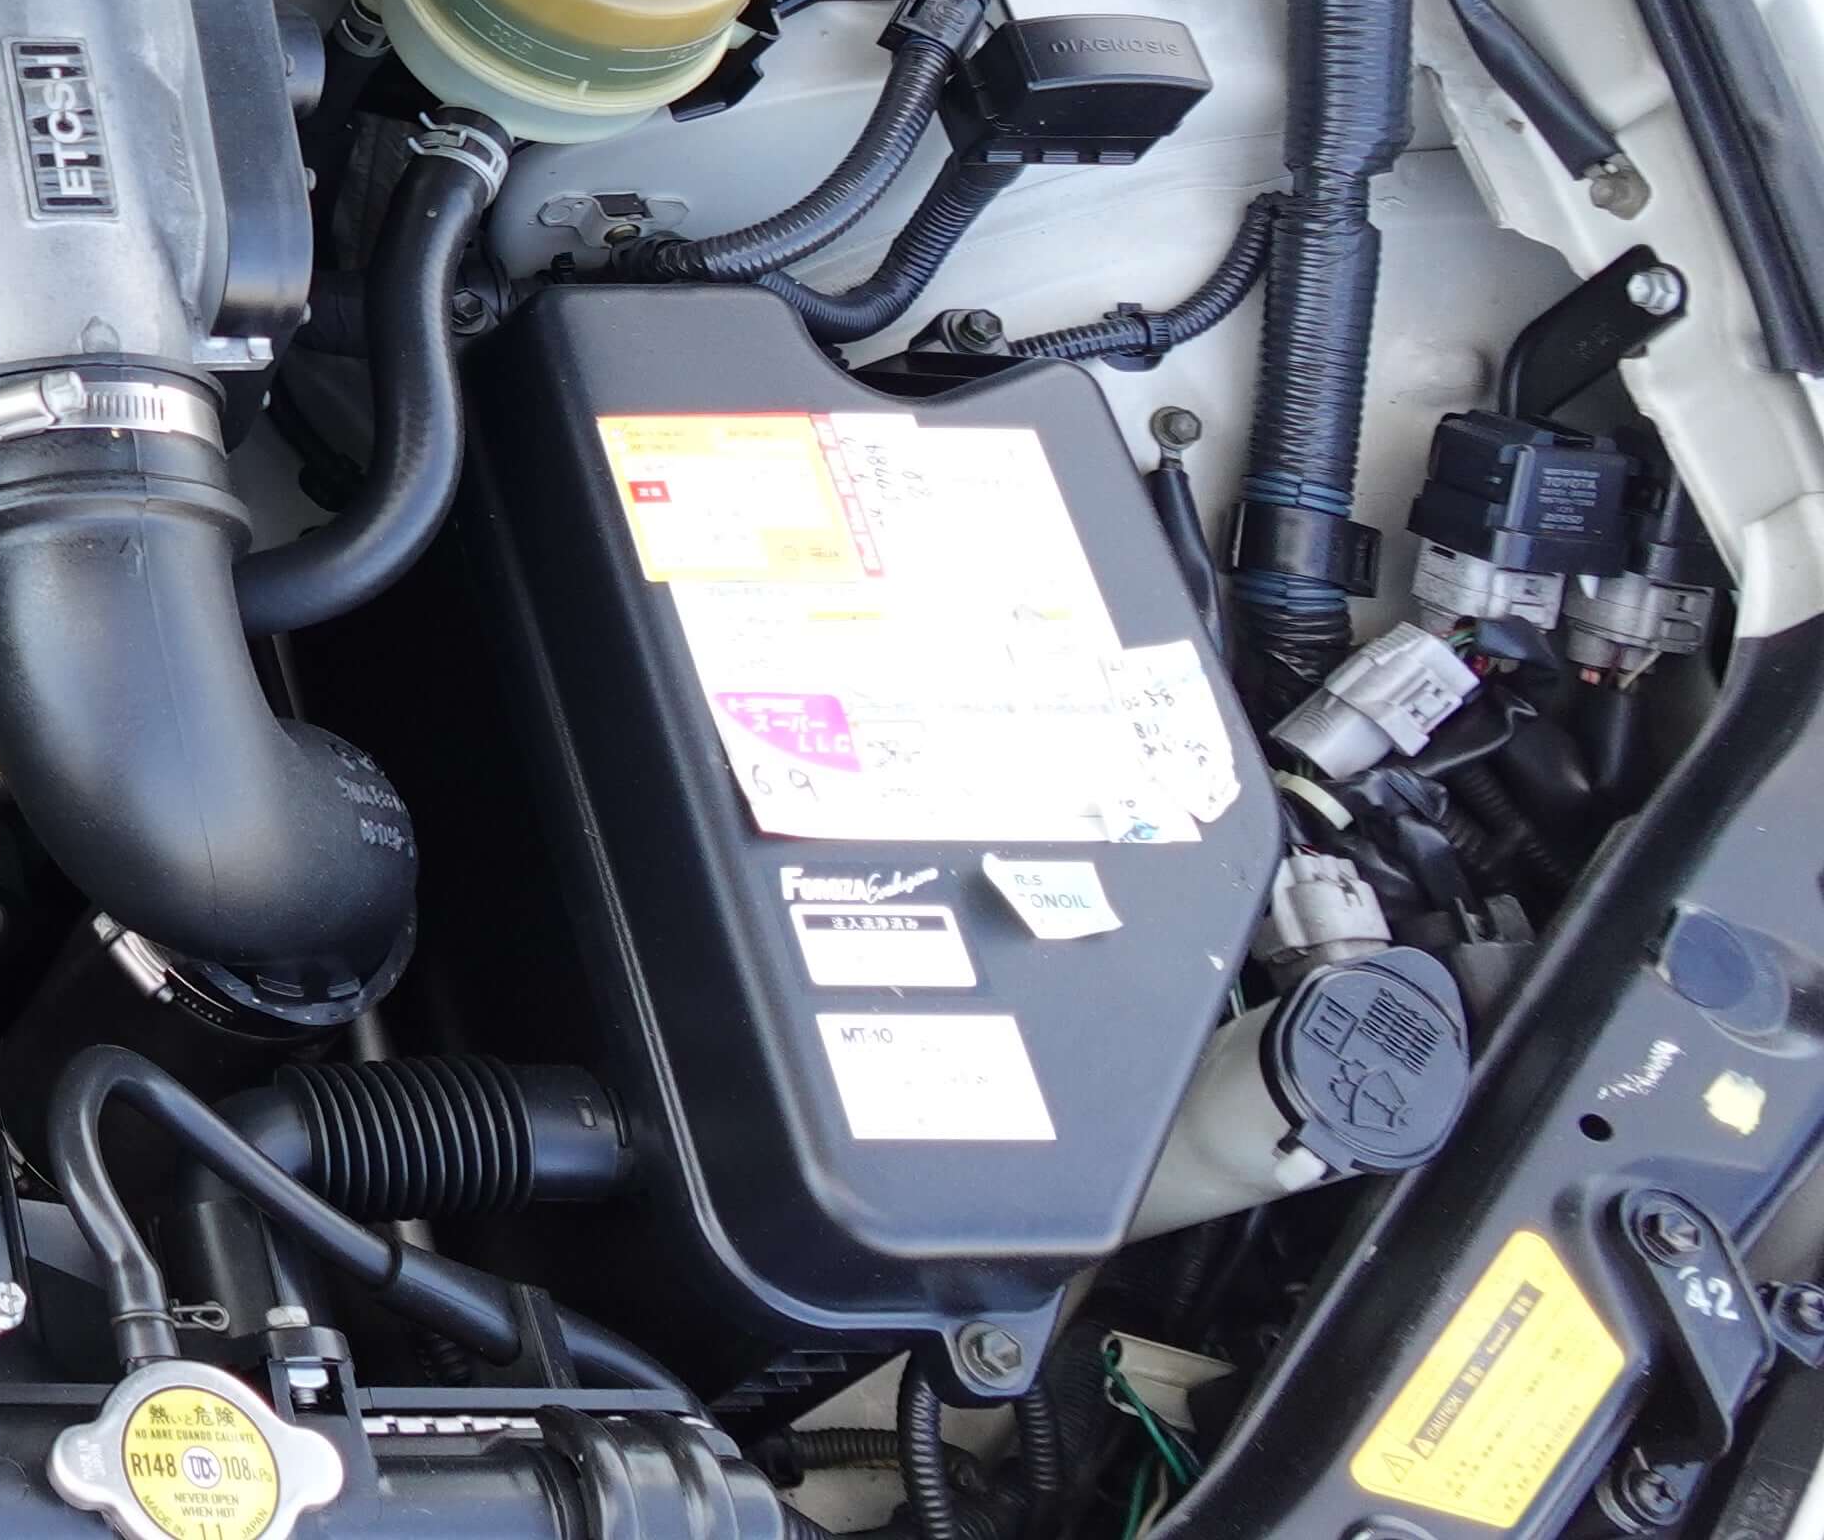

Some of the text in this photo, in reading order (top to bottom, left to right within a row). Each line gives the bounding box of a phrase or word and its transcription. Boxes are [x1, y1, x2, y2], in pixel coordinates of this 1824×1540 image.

[1050, 37, 1184, 57] DIAGNOSIS
[798, 733, 852, 754] LLC
[130, 1452, 178, 1478] R148
[173, 1491, 240, 1506] NEVER OPEN
[141, 1494, 172, 1528] MADE
[241, 1507, 269, 1540] JAPAN
[181, 1506, 237, 1518] WHEN HOT
